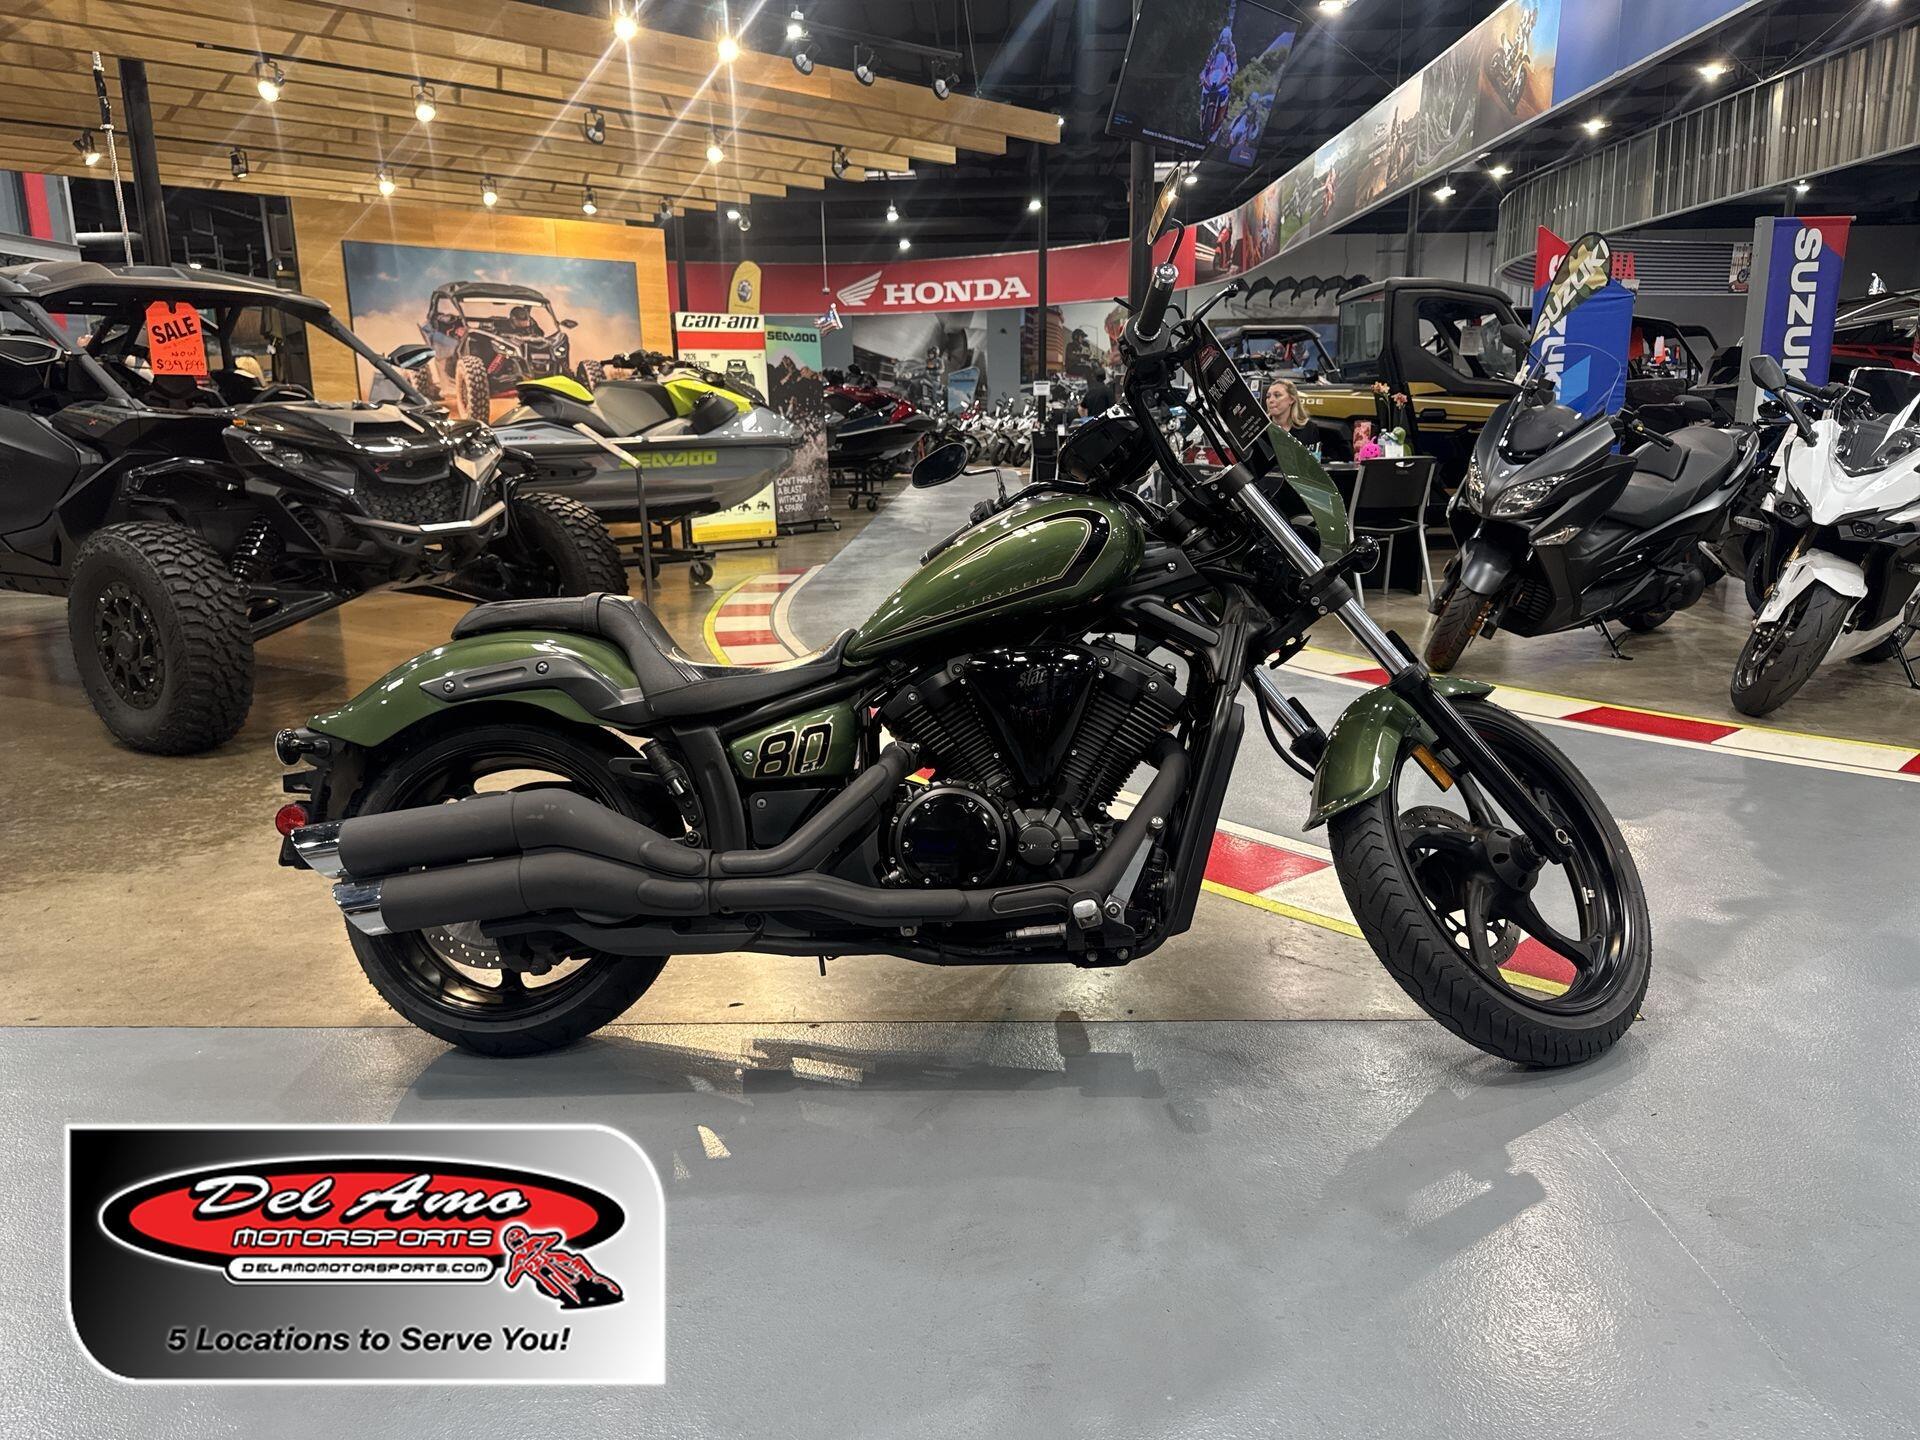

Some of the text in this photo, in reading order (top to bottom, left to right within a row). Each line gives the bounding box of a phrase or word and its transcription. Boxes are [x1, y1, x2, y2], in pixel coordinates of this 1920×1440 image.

[883, 276, 1031, 306] HONDA
[151, 316, 198, 344] SALE
[681, 315, 760, 329] can-am
[778, 485, 802, 495] A BLAST
[778, 493, 807, 504] WITHOUT
[778, 503, 804, 514] A SPARK
[955, 576, 1047, 609] STRYKER
[753, 722, 833, 777] 80
